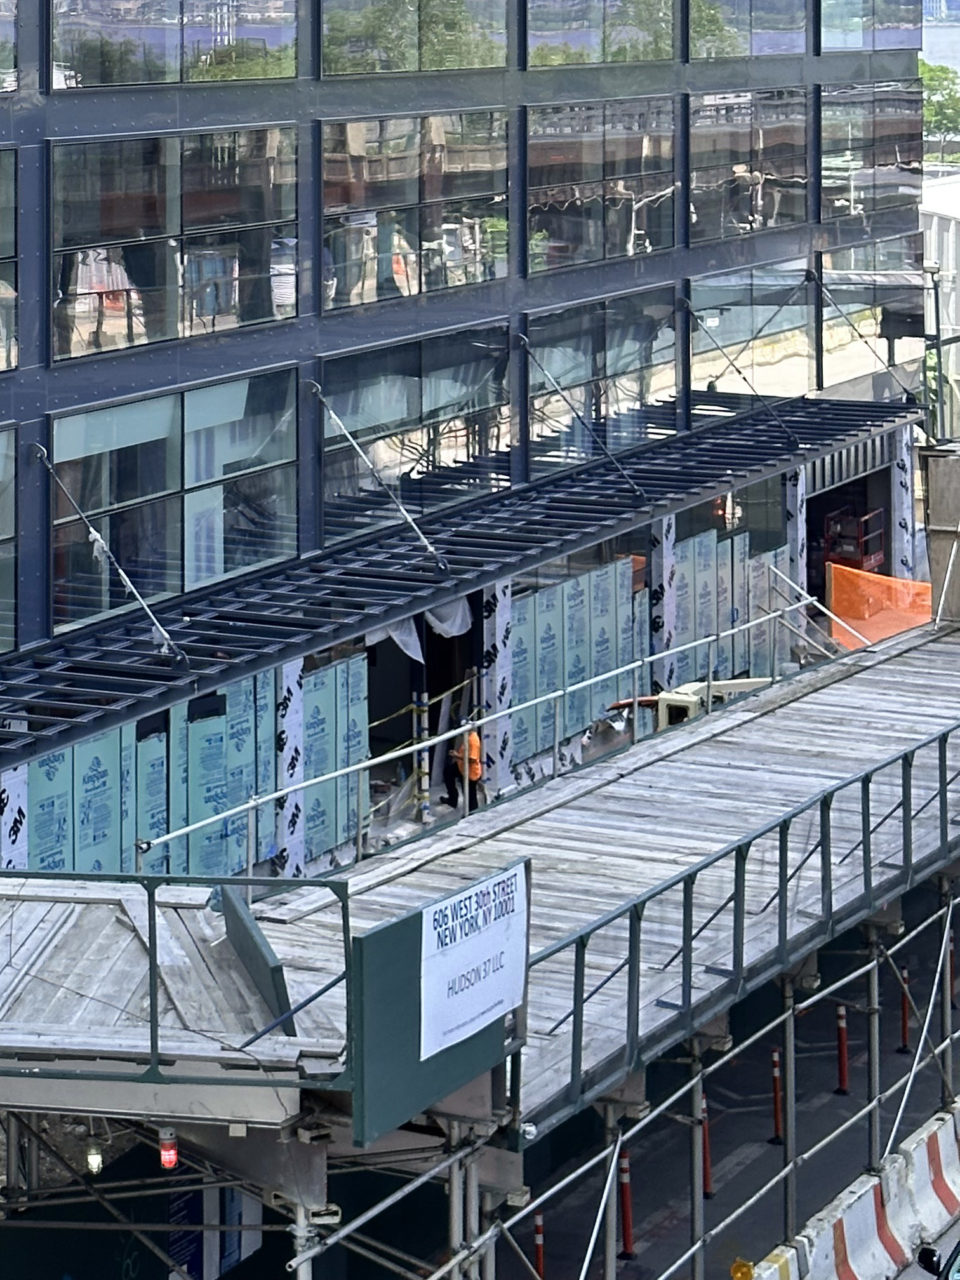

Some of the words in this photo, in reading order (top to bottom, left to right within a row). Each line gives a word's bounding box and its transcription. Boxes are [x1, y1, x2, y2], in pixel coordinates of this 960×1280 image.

[287, 746, 301, 778] 3M
[8, 805, 26, 845] 3M
[288, 803, 301, 835] 3M
[433, 906, 448, 931] 606
[450, 895, 472, 923] WEST
[492, 873, 517, 902] STREET
[437, 923, 458, 949] NEW
[482, 905, 492, 928] NY
[493, 895, 515, 921] 10001
[447, 964, 482, 998] HUDSON
[492, 951, 504, 973] LLC
